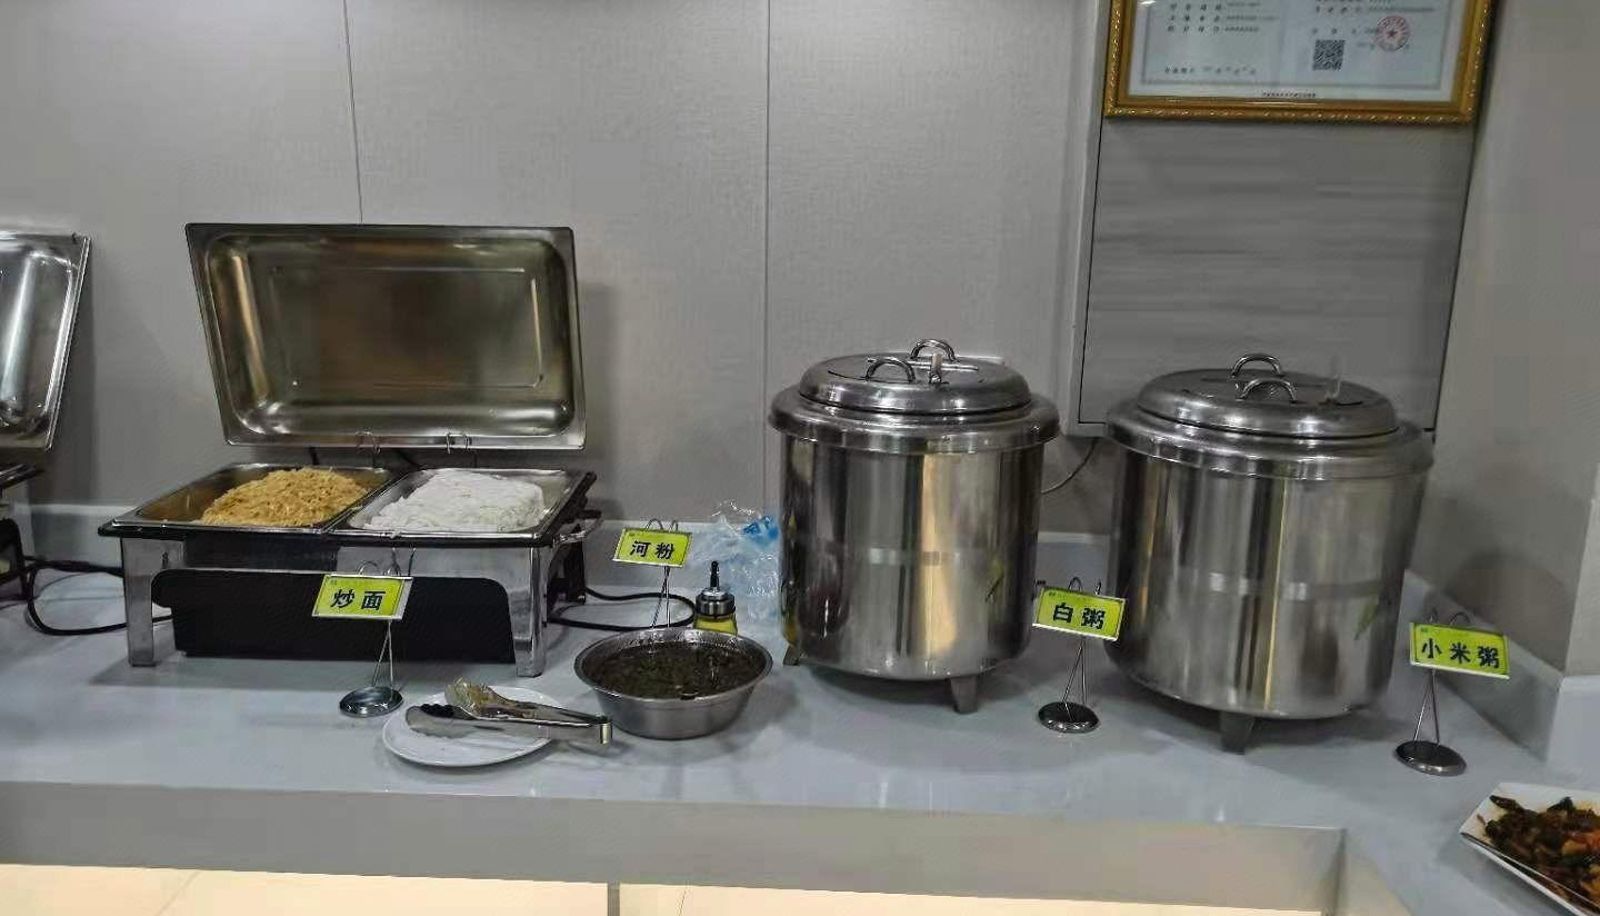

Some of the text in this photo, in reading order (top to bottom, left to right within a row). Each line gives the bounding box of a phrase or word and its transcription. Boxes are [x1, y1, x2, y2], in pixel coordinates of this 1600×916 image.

[630, 540, 675, 560] 河粉
[330, 588, 386, 610] 炒面
[1053, 602, 1106, 630] 白粥
[1421, 638, 1499, 668] 小米粥
